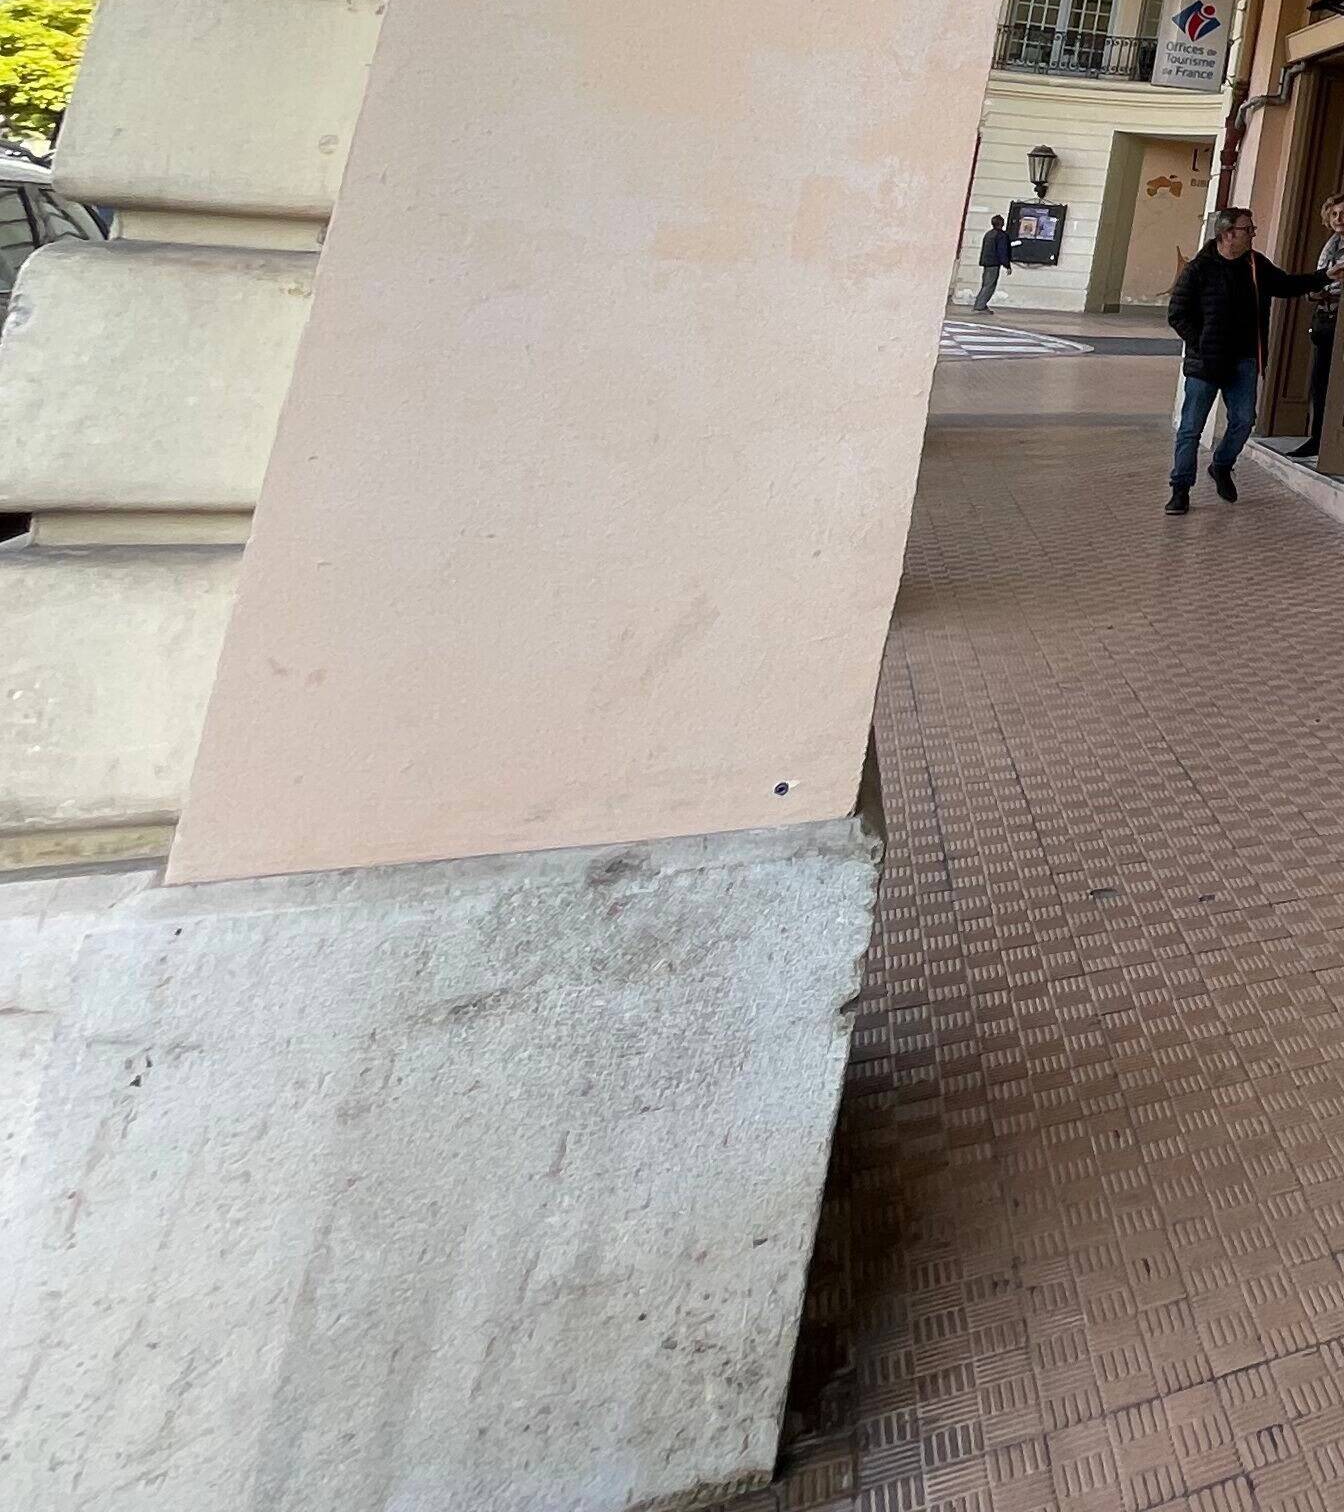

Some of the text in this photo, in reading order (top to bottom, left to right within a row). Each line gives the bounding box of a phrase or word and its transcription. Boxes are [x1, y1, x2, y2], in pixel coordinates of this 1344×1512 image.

[1166, 40, 1204, 55] Offices
[1166, 52, 1216, 68] Tourisme
[1174, 65, 1214, 80] France
